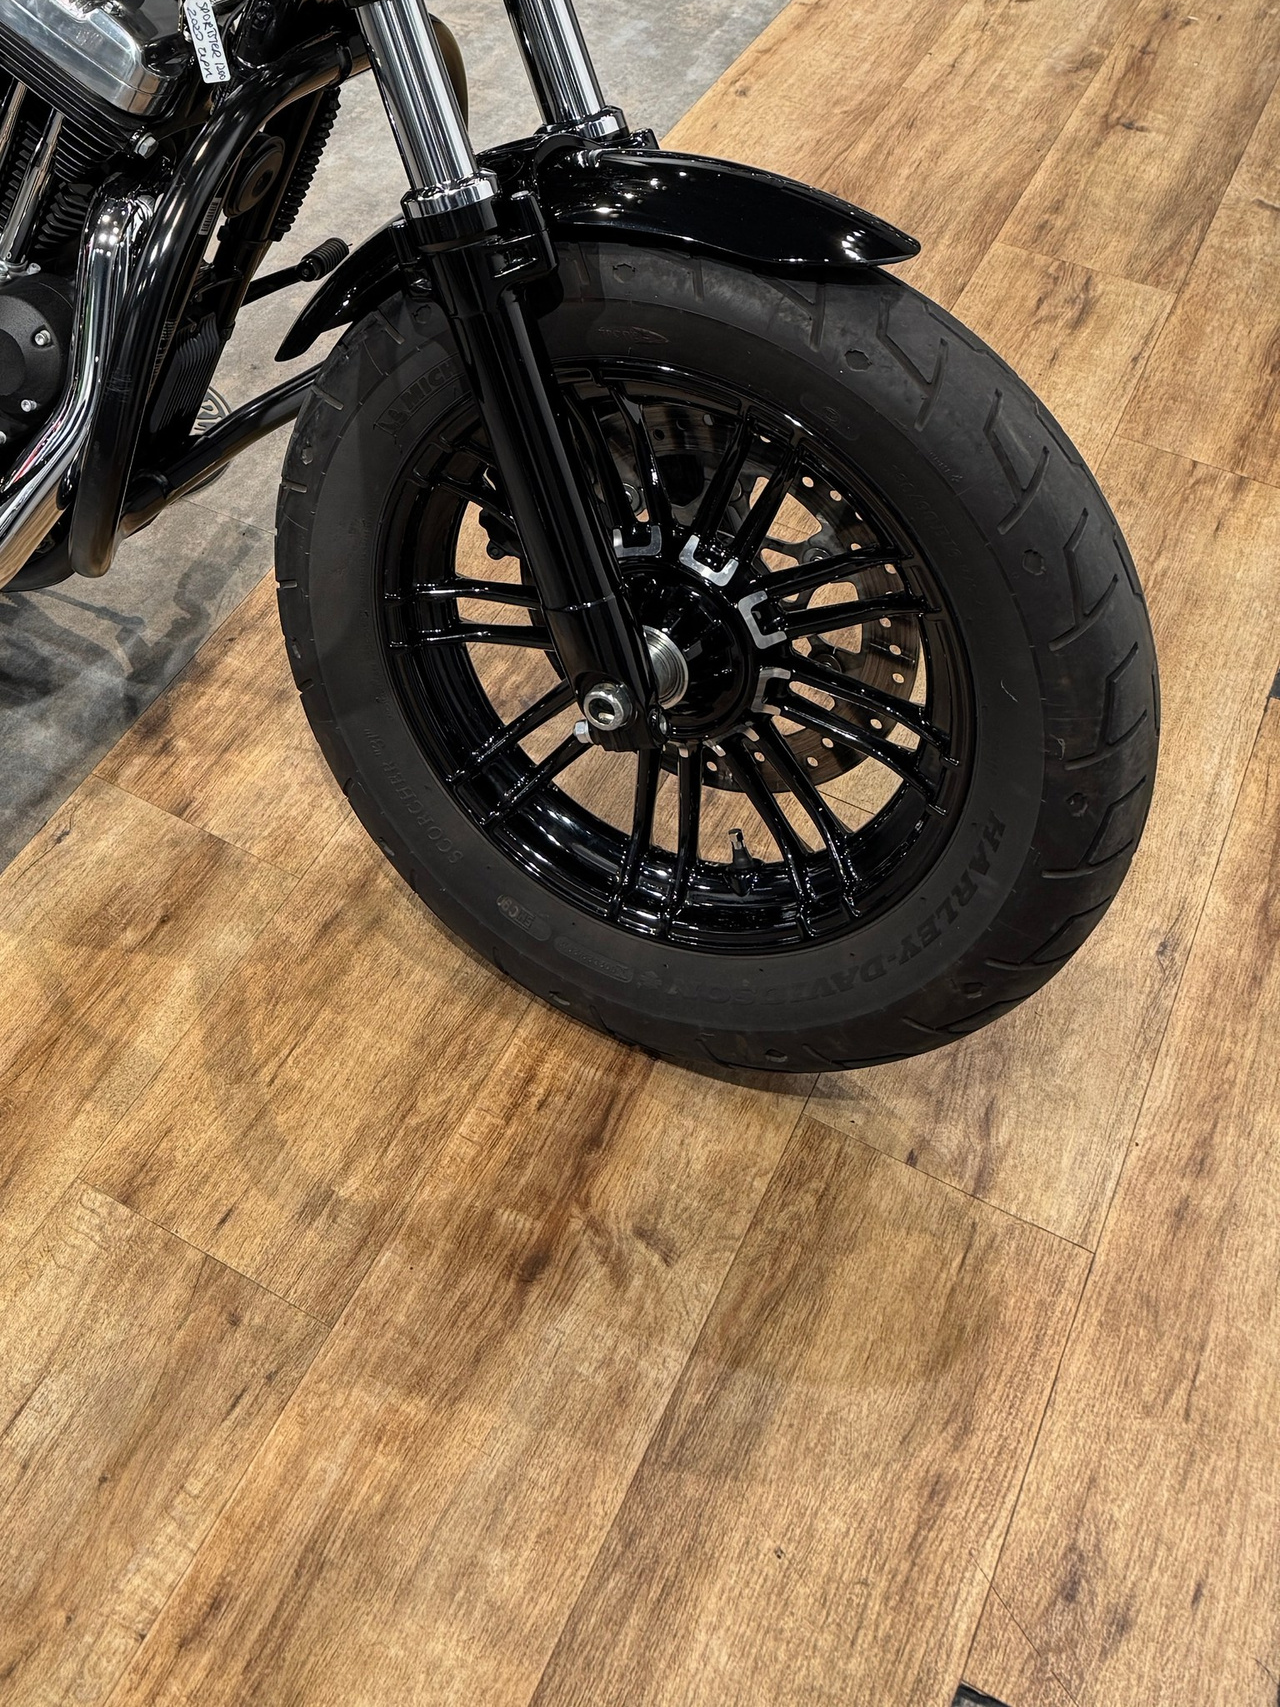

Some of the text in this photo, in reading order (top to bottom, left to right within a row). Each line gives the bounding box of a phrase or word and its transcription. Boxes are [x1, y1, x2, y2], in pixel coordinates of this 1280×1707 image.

[187, 6, 204, 41] 2020
[196, 2, 227, 80] SPORTSTER 1200
[382, 760, 464, 864] SCORCHER
[666, 808, 1007, 1006] HARLEY-DAVIDSON
